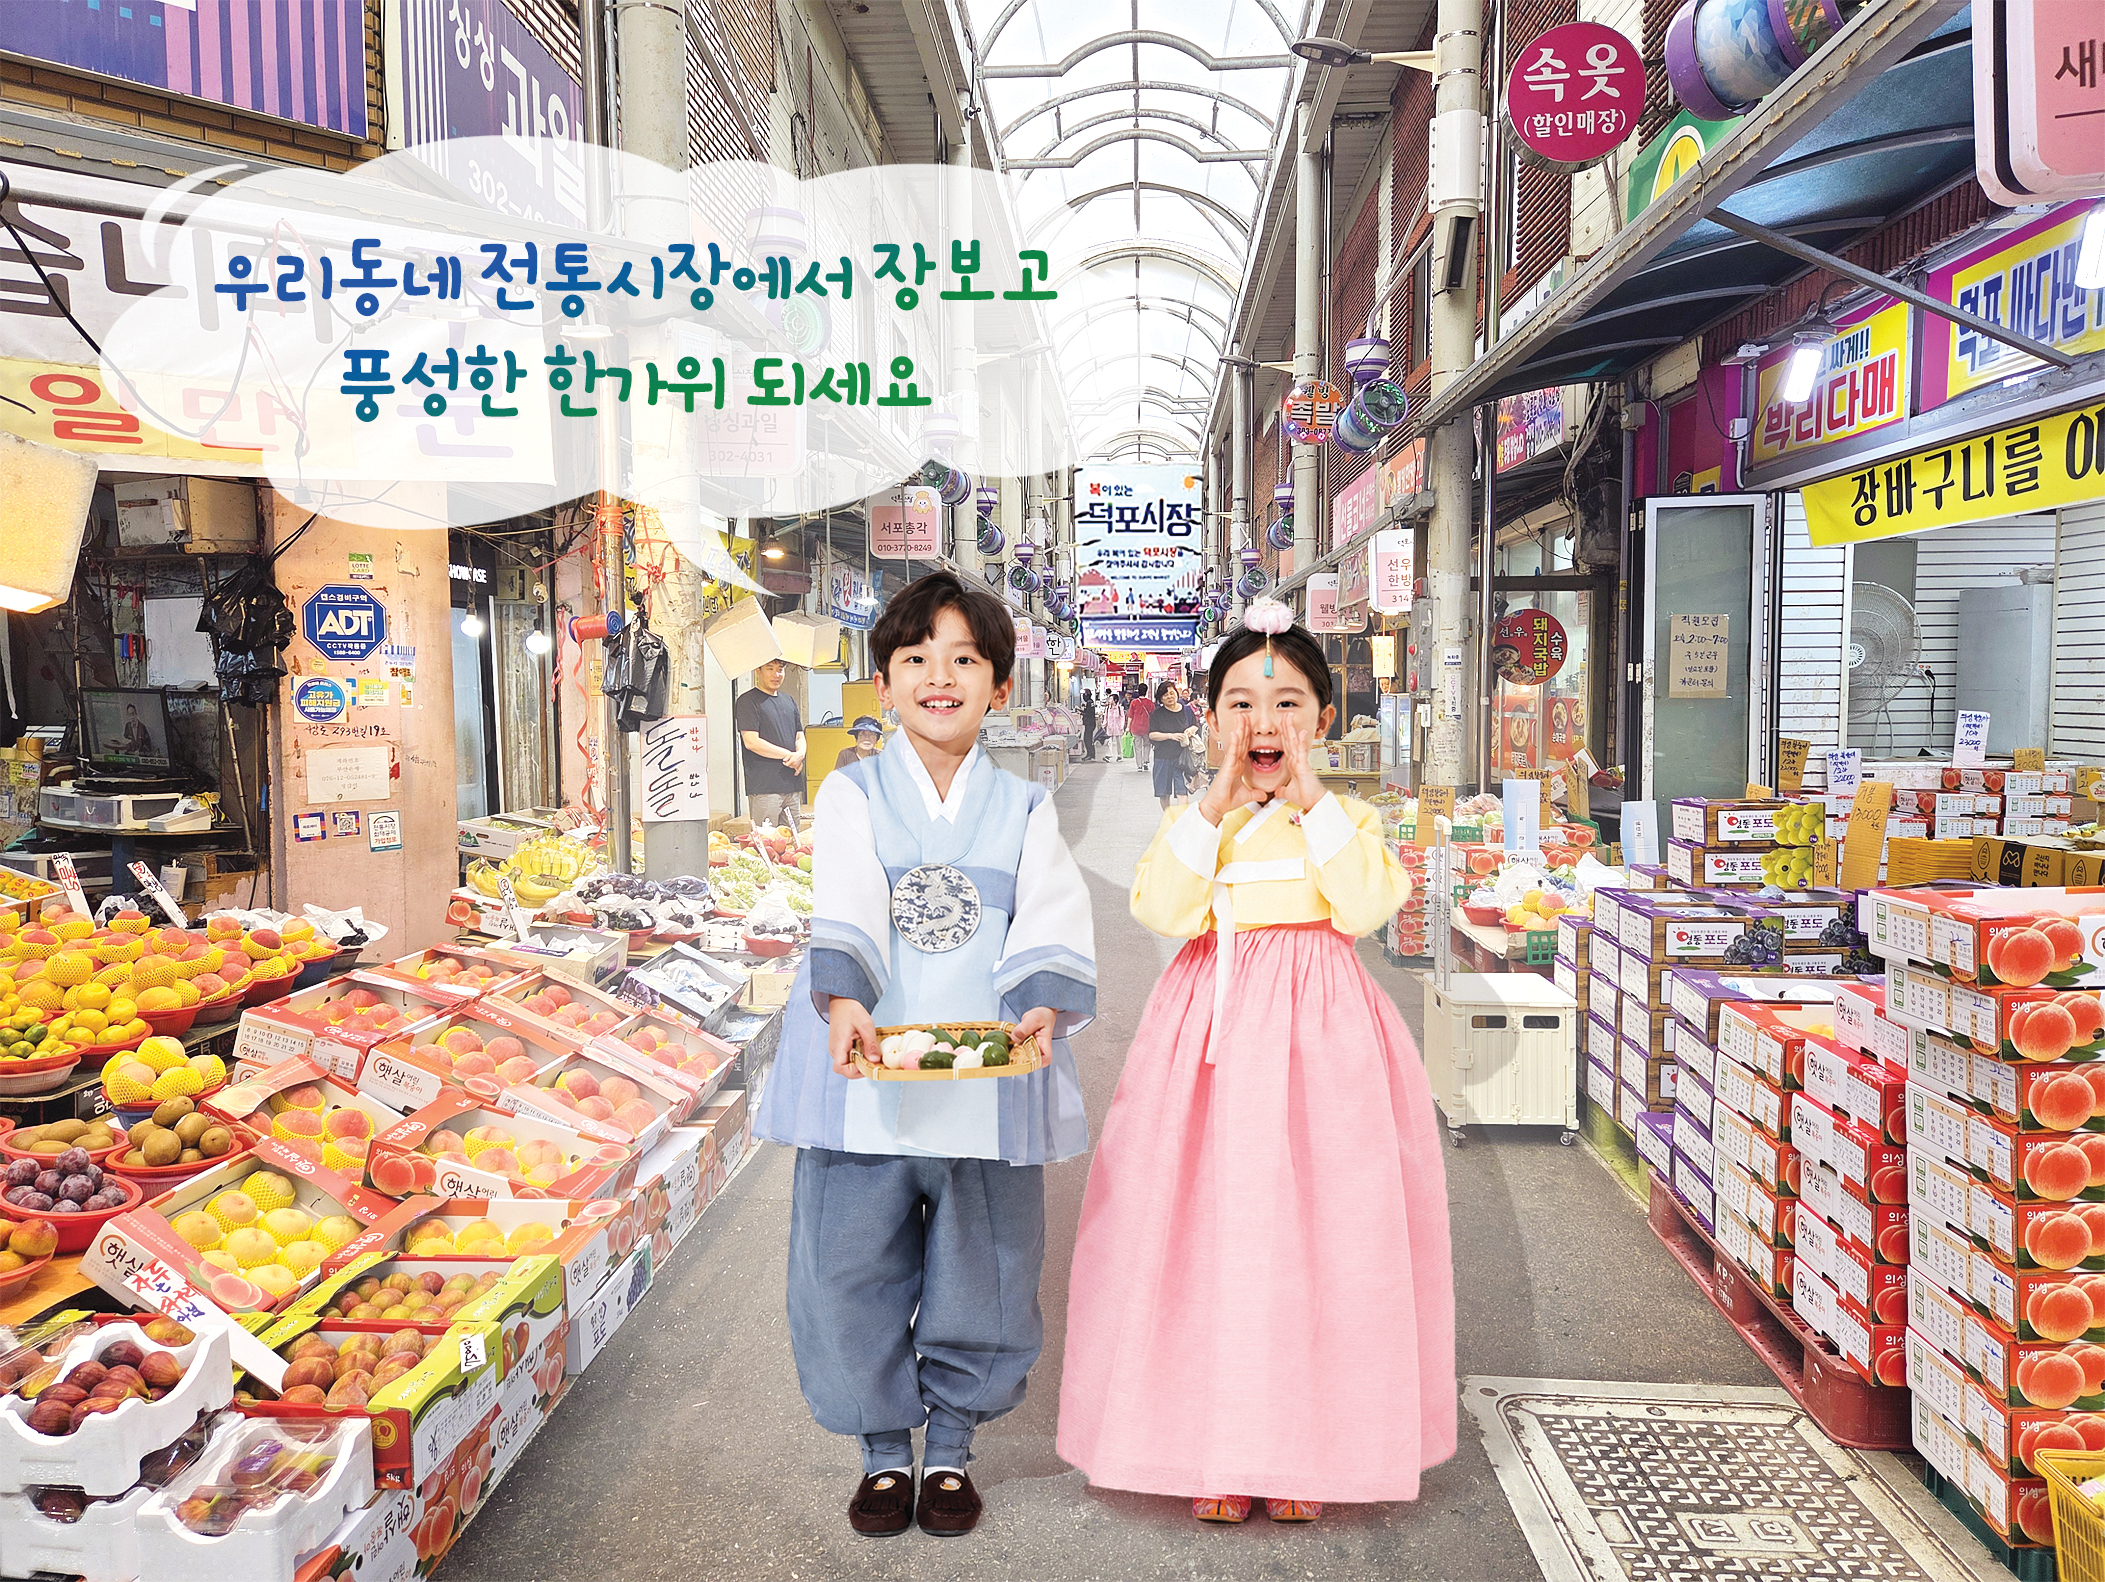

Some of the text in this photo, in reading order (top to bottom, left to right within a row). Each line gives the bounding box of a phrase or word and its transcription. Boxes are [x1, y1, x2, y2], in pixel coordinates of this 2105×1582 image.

[1523, 43, 1626, 103] 속옷
[1523, 109, 1626, 139] (할인매장)
[1763, 352, 1897, 451] 박리다매
[1851, 426, 2042, 527] 장바구니를
[1078, 498, 1202, 537] 덕포시장
[881, 521, 928, 535] 서포총각
[1388, 558, 1412, 572] 선우
[1388, 573, 1412, 588] 한방
[318, 609, 373, 636] ADT
[1532, 616, 1549, 677] 돼지국밥
[1550, 632, 1563, 661] 수육
[307, 690, 334, 700] 고유가
[1858, 783, 1877, 804] 거봉
[1851, 807, 1882, 821] 13000
[1753, 818, 1774, 828] 포도
[1740, 861, 1762, 871] 포도
[1800, 918, 1823, 929] 포도
[1704, 934, 1728, 945] 포도
[1989, 927, 2009, 938] 의성
[1838, 998, 1854, 1025] 햇살
[2010, 1001, 2031, 1013] 의성
[242, 1046, 258, 1060] 햇살
[379, 1062, 420, 1087] 햇살 어린
[1809, 1055, 1826, 1083] 햇살
[2029, 1071, 2050, 1083] 의성
[403, 1081, 423, 1095] 복숭아
[1795, 1109, 1812, 1136] 햇살
[2025, 1142, 2046, 1154] 의성
[1881, 1153, 1904, 1164] 의성
[1804, 1165, 1821, 1193] 햇살
[481, 1187, 498, 1199] 어린
[2026, 1211, 2047, 1222] 의성
[1799, 1221, 1815, 1248] 햇살
[573, 1258, 590, 1286] 햇살
[1884, 1274, 1907, 1285] 의성
[1798, 1279, 1815, 1306] 햇살
[2028, 1282, 2048, 1294] 의성
[1885, 1335, 1907, 1346] 의성
[2018, 1350, 2039, 1361] 의성
[499, 1414, 519, 1449] 햇살
[2020, 1421, 2040, 1433] 의성
[461, 1456, 473, 1474] 의성
[385, 1472, 400, 1482] 5kg
[2018, 1486, 2039, 1500] 의성
[383, 1494, 411, 1536] 햇살
